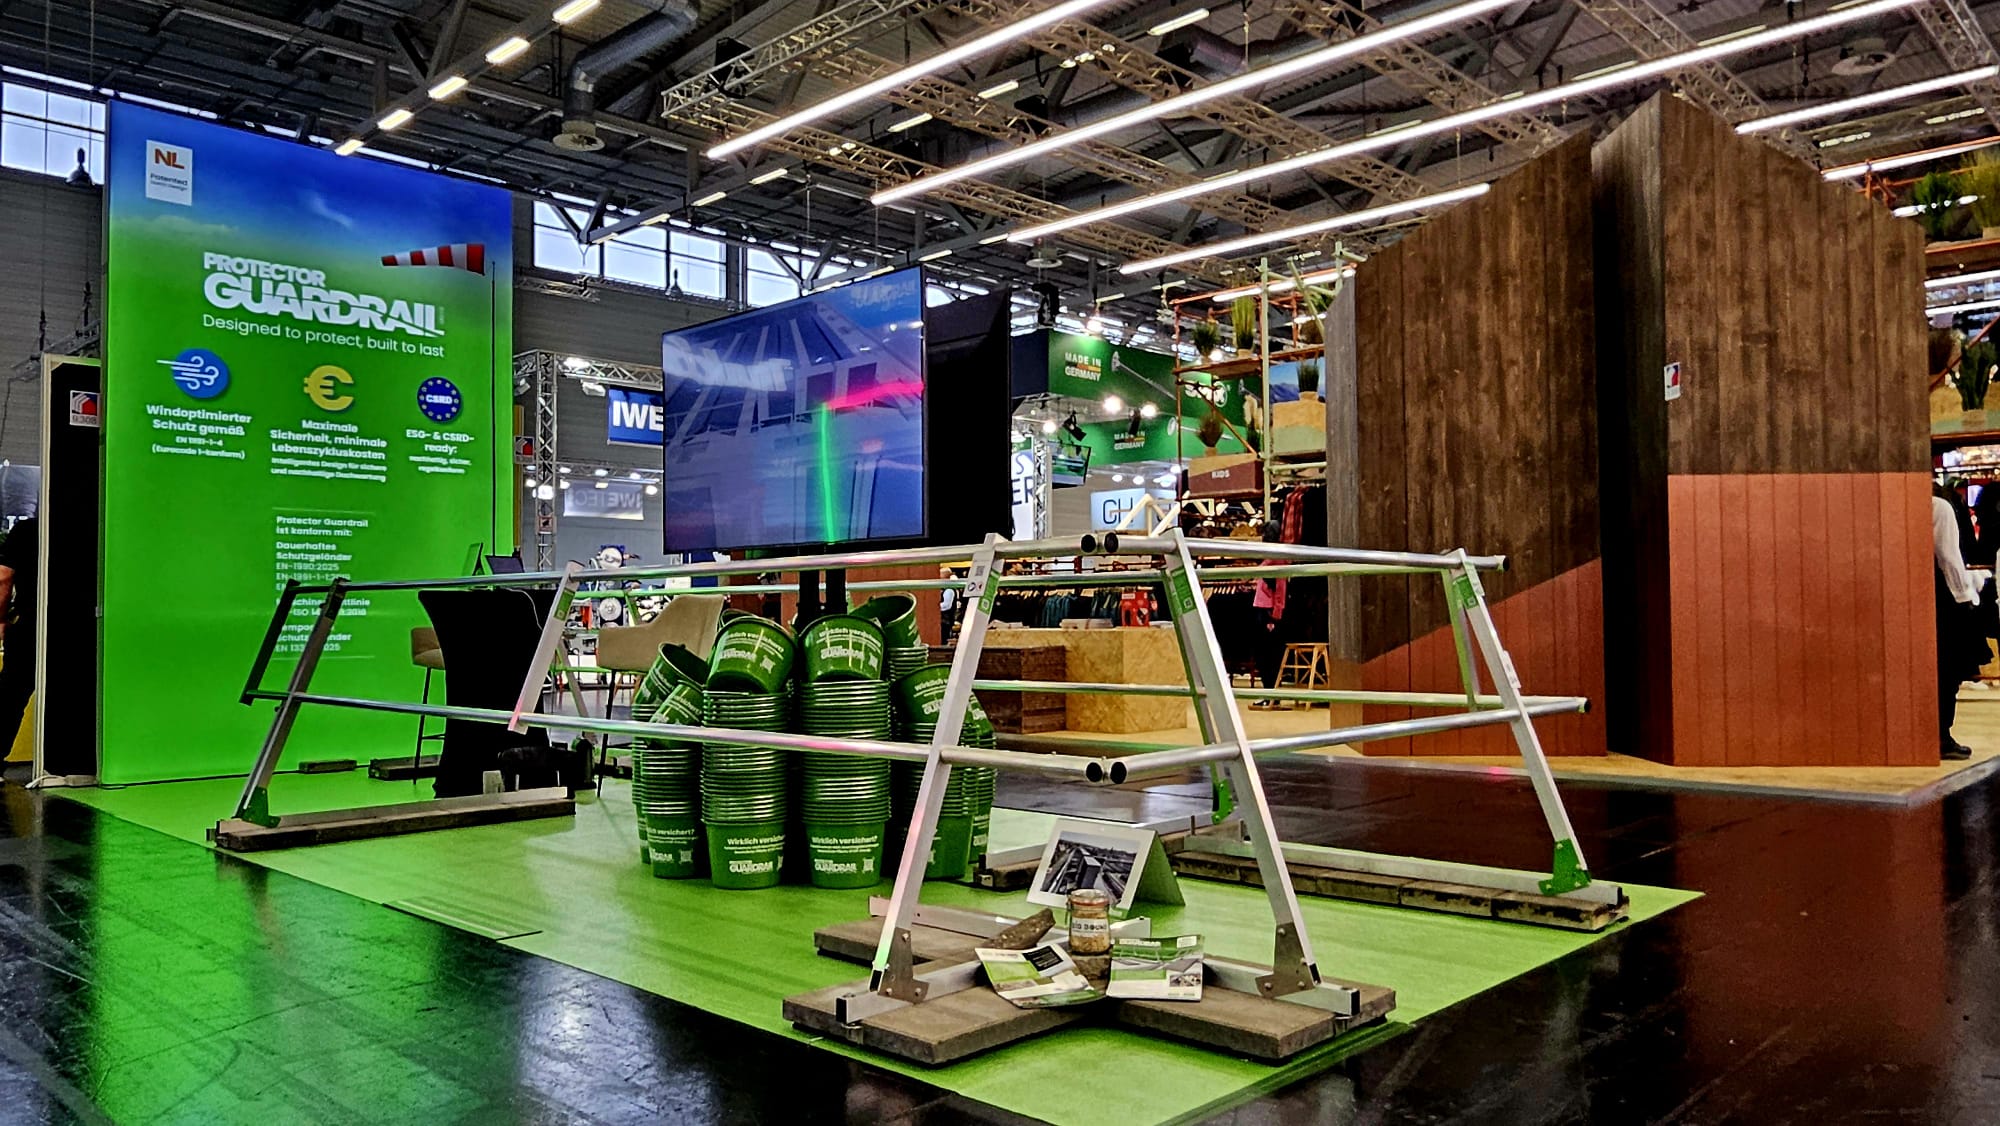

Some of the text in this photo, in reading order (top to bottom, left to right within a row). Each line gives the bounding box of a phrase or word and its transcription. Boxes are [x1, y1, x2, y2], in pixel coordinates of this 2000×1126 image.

[154, 148, 185, 170] NL
[203, 251, 326, 287] PROTECTOR
[203, 272, 445, 338] GUARDRAIL
[203, 314, 445, 357] Designed to protect, built to last
[1065, 352, 1102, 367] MADE IN
[1065, 366, 1102, 382] GERMANY
[146, 404, 252, 424] Windoptimierter
[152, 419, 197, 432] Schutz
[301, 420, 358, 433] Maximale
[269, 429, 388, 448] Sicherheit, minimale
[271, 443, 386, 460] Lebenszykluskosten
[1114, 441, 1145, 451] GERMANY
[276, 515, 369, 528] Protector Guardrail
[276, 527, 289, 535] ist
[290, 527, 332, 536] konform
[276, 541, 337, 551] Dauerhaftes
[276, 552, 353, 562] Schutzgeländer
[727, 837, 759, 846] Wirklich
[811, 836, 838, 845] Wirklich
[729, 862, 774, 874] GUARDRAIL
[814, 861, 858, 873] GUARDRAIL
